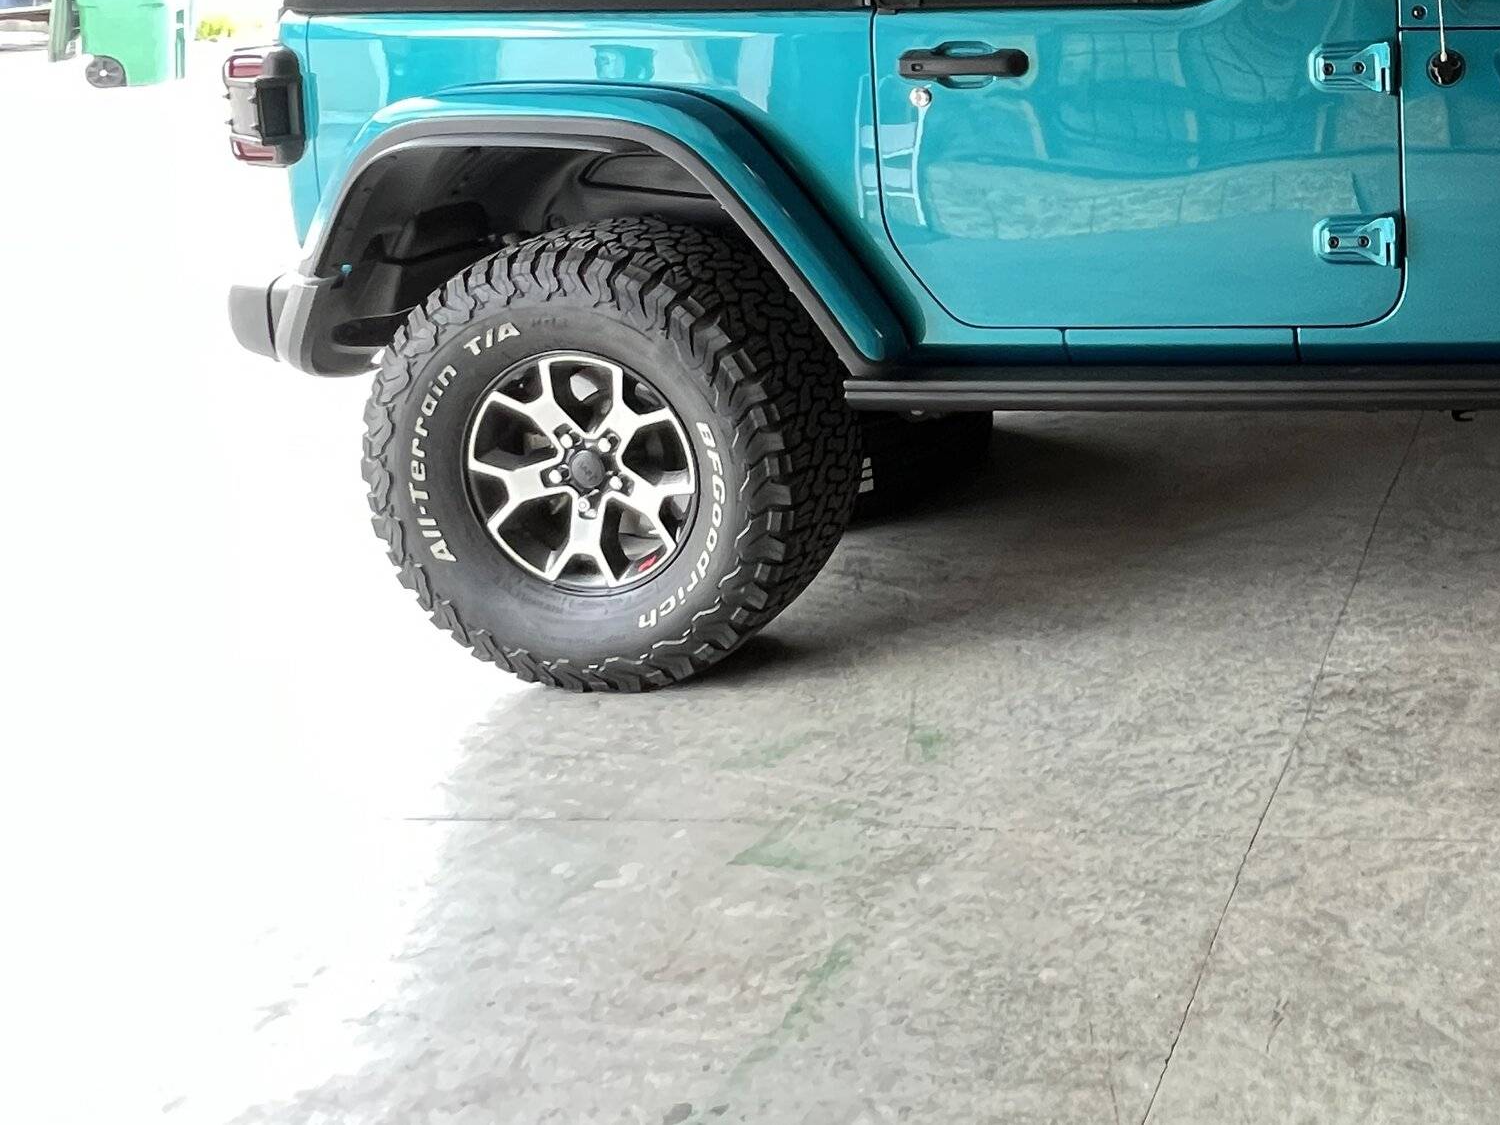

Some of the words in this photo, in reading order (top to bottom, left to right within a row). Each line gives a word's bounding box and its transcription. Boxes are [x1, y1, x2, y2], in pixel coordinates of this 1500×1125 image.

[408, 363, 459, 563] All-Terrain
[463, 321, 522, 356] T/A
[637, 421, 728, 629] BFGoodrich
